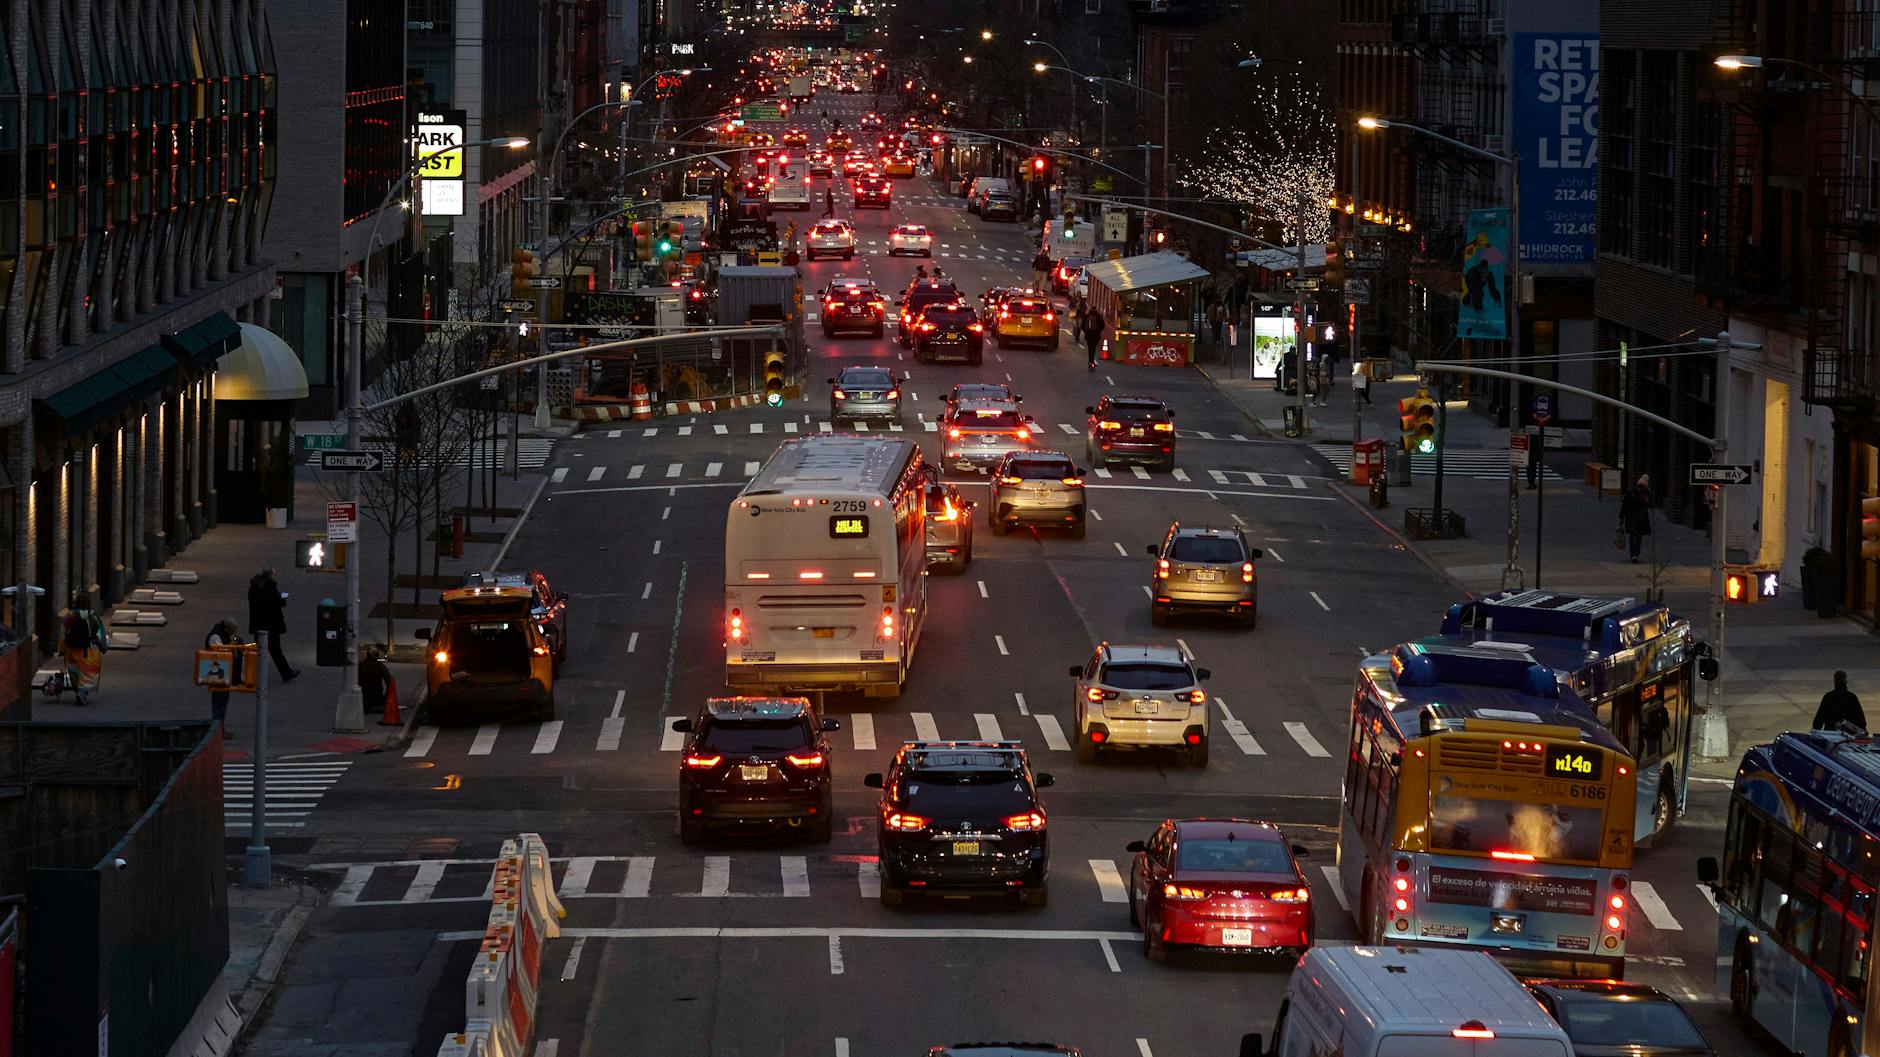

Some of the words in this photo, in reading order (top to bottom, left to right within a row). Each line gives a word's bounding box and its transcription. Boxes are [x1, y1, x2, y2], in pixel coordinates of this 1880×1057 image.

[1557, 176, 1588, 187] John
[1532, 243, 1584, 254] HIDROCK
[306, 435, 315, 447] W
[321, 435, 332, 448] 18
[330, 457, 346, 465] ONE
[355, 457, 374, 465] WAY
[1699, 470, 1718, 479] ONE
[1724, 471, 1743, 479] WAY
[785, 506, 795, 514] City
[833, 500, 867, 512] 2759
[1570, 785, 1606, 800] 6186
[1432, 874, 1441, 883] El
[1442, 878, 1474, 887] exceso
[1475, 878, 1487, 887] de
[1489, 879, 1532, 890] velocidad
[1534, 884, 1565, 894] arruina
[1566, 886, 1593, 896] vidas.
[1432, 885, 1469, 897] Reduzca
